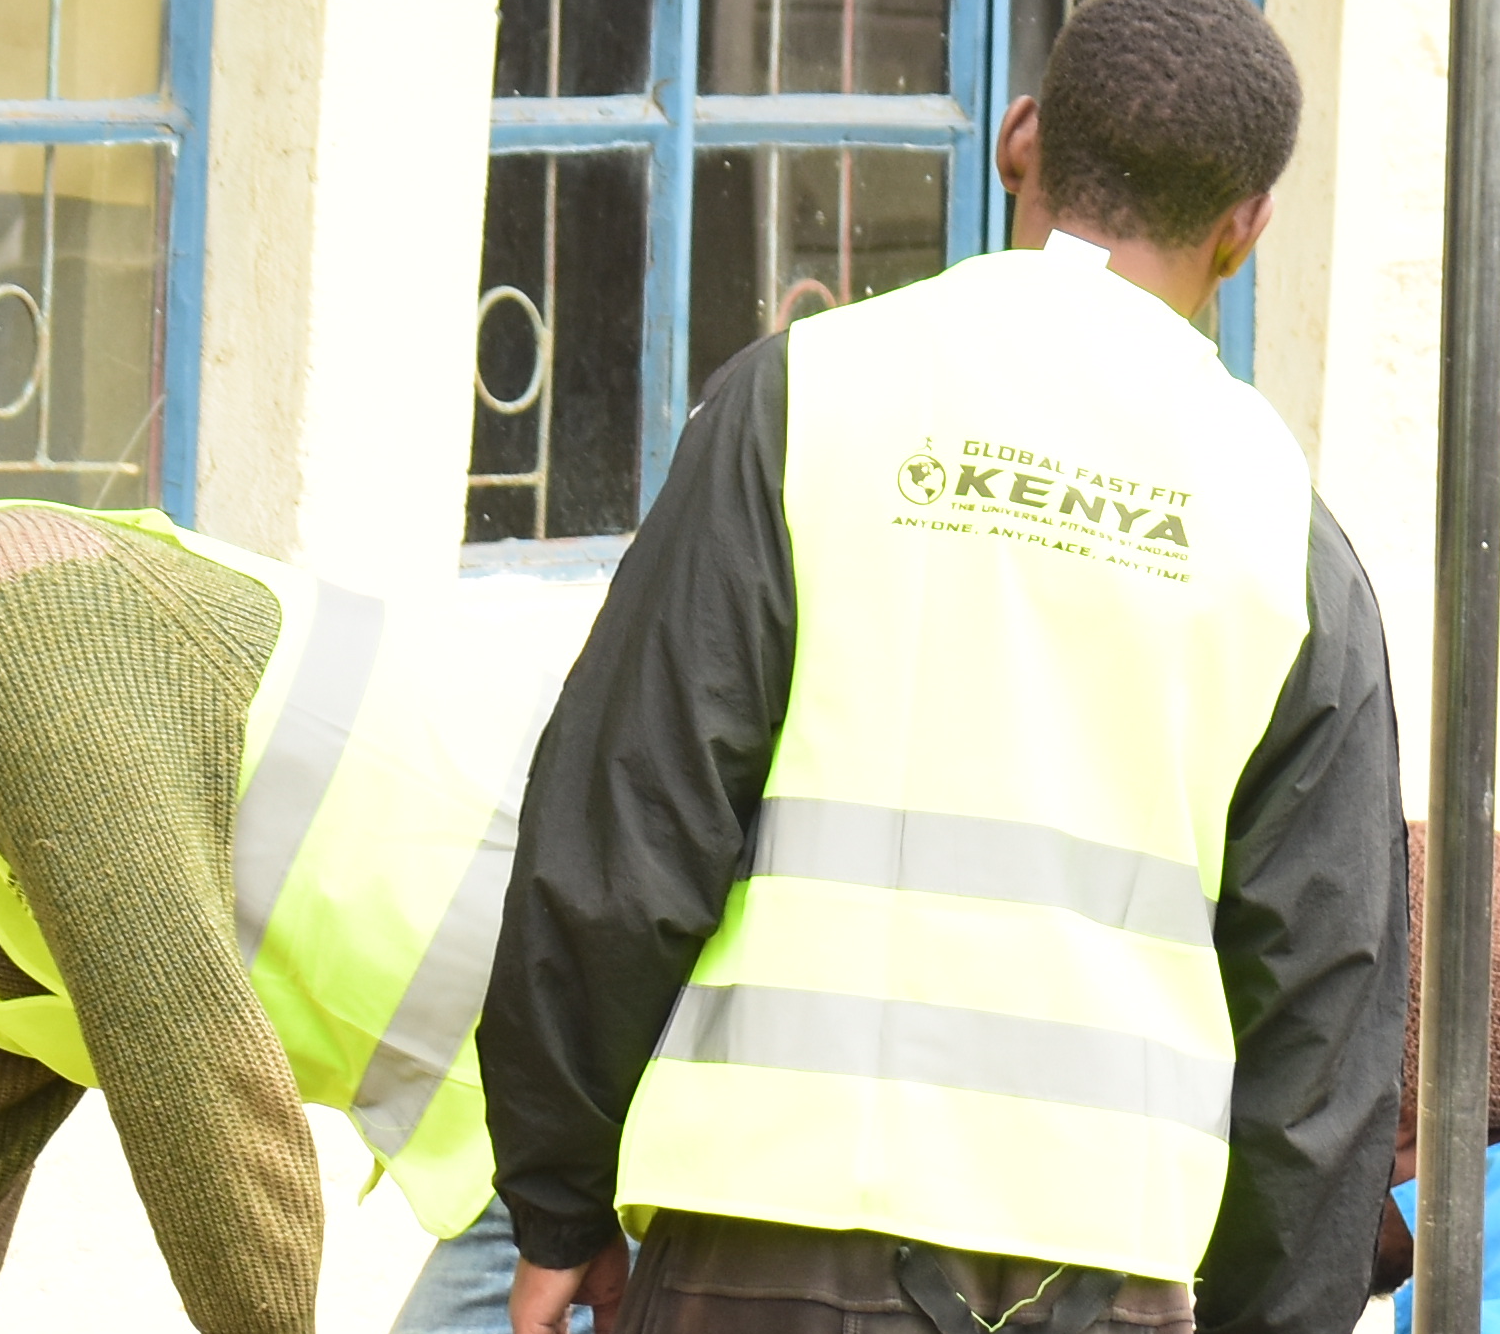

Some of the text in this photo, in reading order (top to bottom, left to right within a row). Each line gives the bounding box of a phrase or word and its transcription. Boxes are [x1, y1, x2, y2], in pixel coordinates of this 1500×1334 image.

[963, 440, 1192, 508] GLOBAL FAST FIT
[951, 502, 1189, 561] THE UNIVERSAL FITNESS STANDARD
[954, 464, 1190, 548] KENYA
[1105, 555, 1191, 584] ANYTIME
